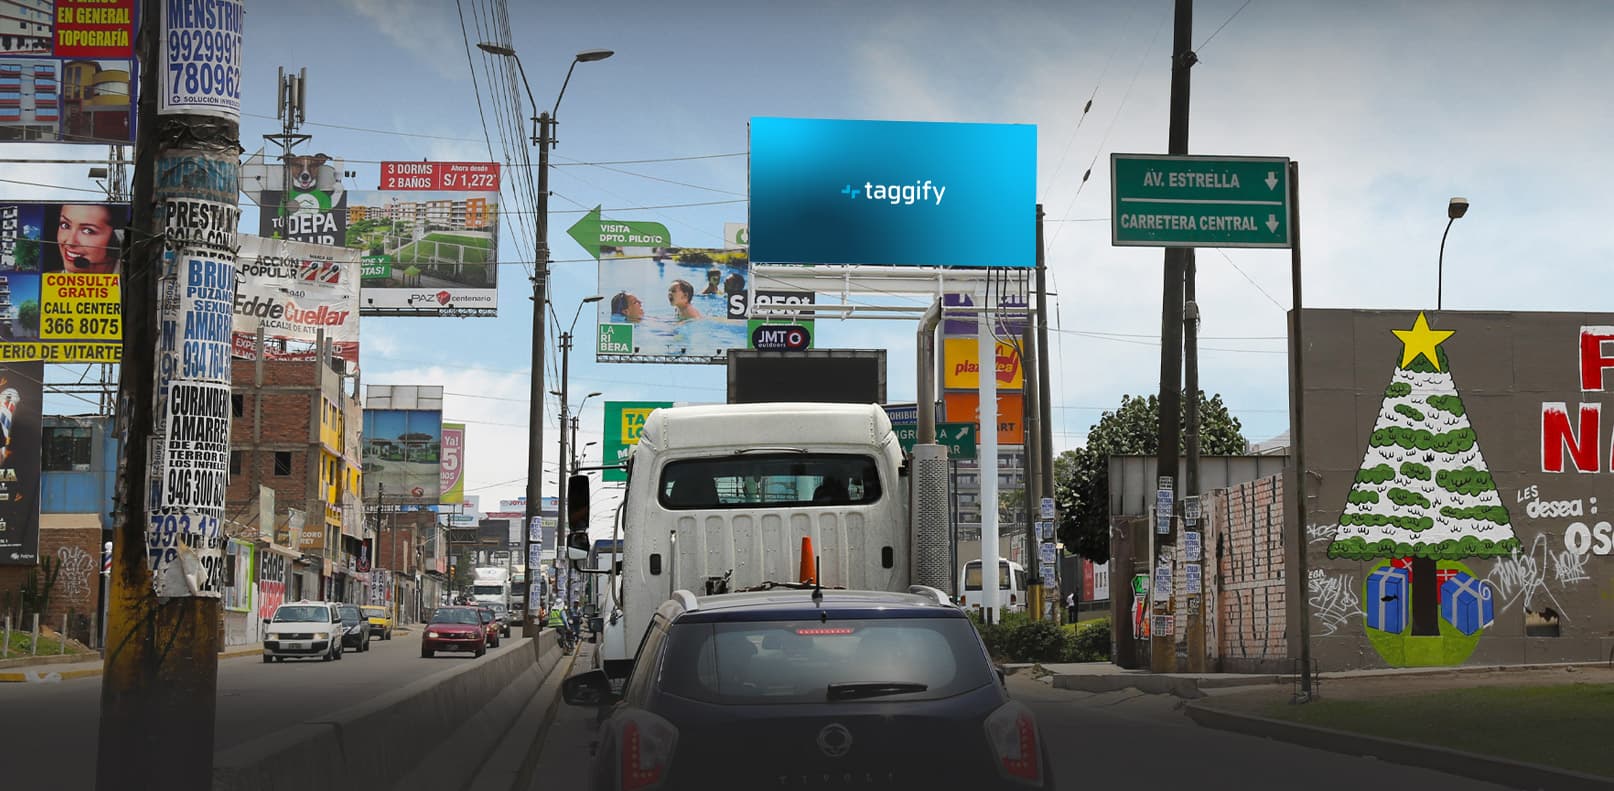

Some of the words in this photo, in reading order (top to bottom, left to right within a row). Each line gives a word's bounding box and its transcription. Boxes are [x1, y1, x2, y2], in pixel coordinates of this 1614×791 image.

[58, 7, 73, 23] EN
[76, 8, 130, 24] GENERAL
[58, 28, 128, 46] TOPOGRAFÍA
[388, 164, 394, 174] 3
[398, 164, 432, 174] DORMS
[388, 178, 395, 188] 2
[398, 176, 432, 188] BAÑOS
[444, 174, 456, 186] S/
[1144, 172, 1164, 186] AV.
[1169, 172, 1240, 188] ESTRELLA
[864, 180, 946, 205] taggify
[272, 218, 284, 228] TU
[288, 212, 338, 234] DEPA
[600, 224, 630, 232] VISITA
[1120, 214, 1196, 230] CARRETERA
[1200, 216, 1258, 231] CENTRAL
[628, 235, 662, 243] PILOTO
[254, 255, 299, 268] ACCIÓN
[242, 264, 298, 280] POPULAR
[47, 275, 118, 286] CONSULTA
[58, 288, 108, 298] GRATIS
[411, 294, 435, 302] PAZ
[44, 303, 72, 314] CALL
[76, 303, 120, 315] CENTER
[233, 294, 284, 319] Edde
[284, 301, 349, 326] Cuellar
[44, 318, 74, 334] 366
[79, 318, 118, 334] 8075
[600, 326, 614, 334] LA
[758, 330, 787, 343] JMT
[41, 346, 58, 360] DE
[64, 346, 122, 360] VITARTE
[600, 343, 628, 352] BERA
[170, 416, 228, 444] AMARRES
[169, 441, 190, 450] DE
[194, 442, 227, 454] AMOR
[168, 450, 217, 462] TERROR
[169, 460, 191, 468] LOS
[168, 468, 192, 505] 946
[194, 468, 213, 506] 300
[1517, 485, 1538, 503] LES
[1526, 498, 1583, 518] desea
[1564, 522, 1614, 556] OS
